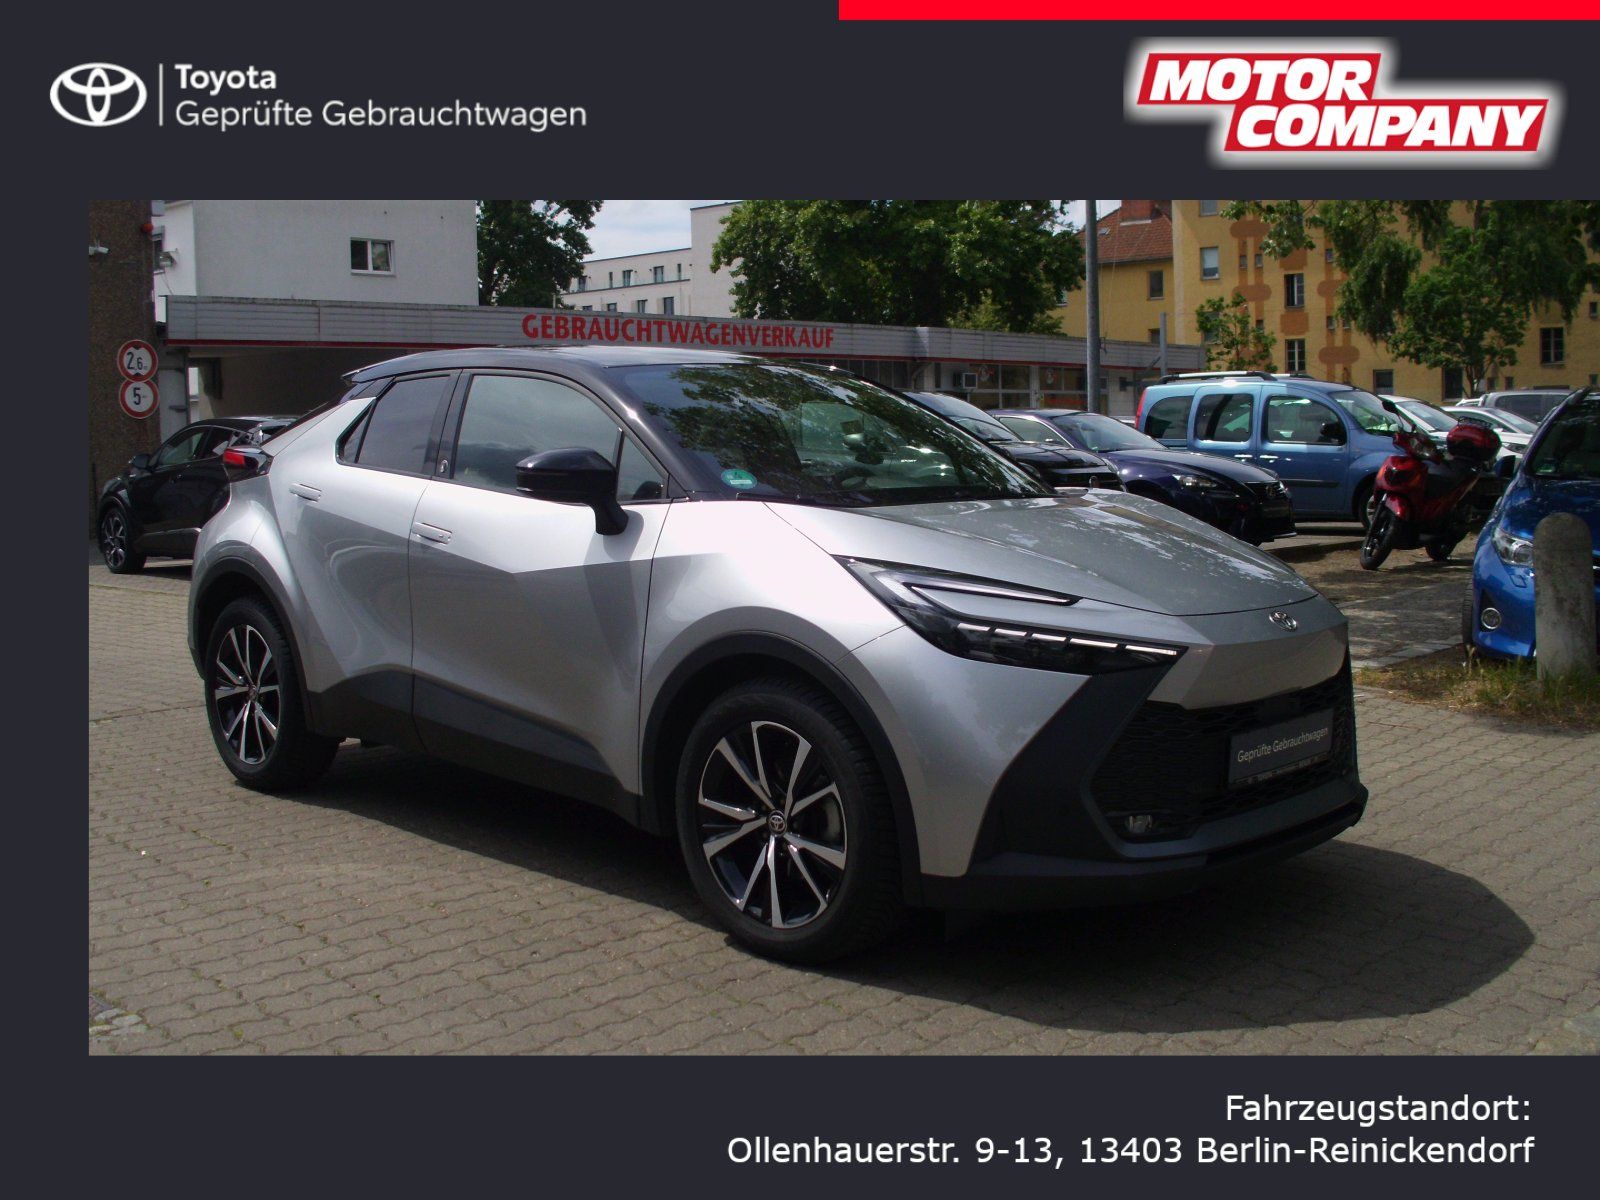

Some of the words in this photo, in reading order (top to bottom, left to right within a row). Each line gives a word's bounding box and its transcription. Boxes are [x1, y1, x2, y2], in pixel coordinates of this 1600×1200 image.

[521, 313, 834, 348] GEBRAUCHTWAGENVERKAUF
[1237, 743, 1271, 764] Geprüfte
[1272, 727, 1329, 752] Gebrauchtwagen
